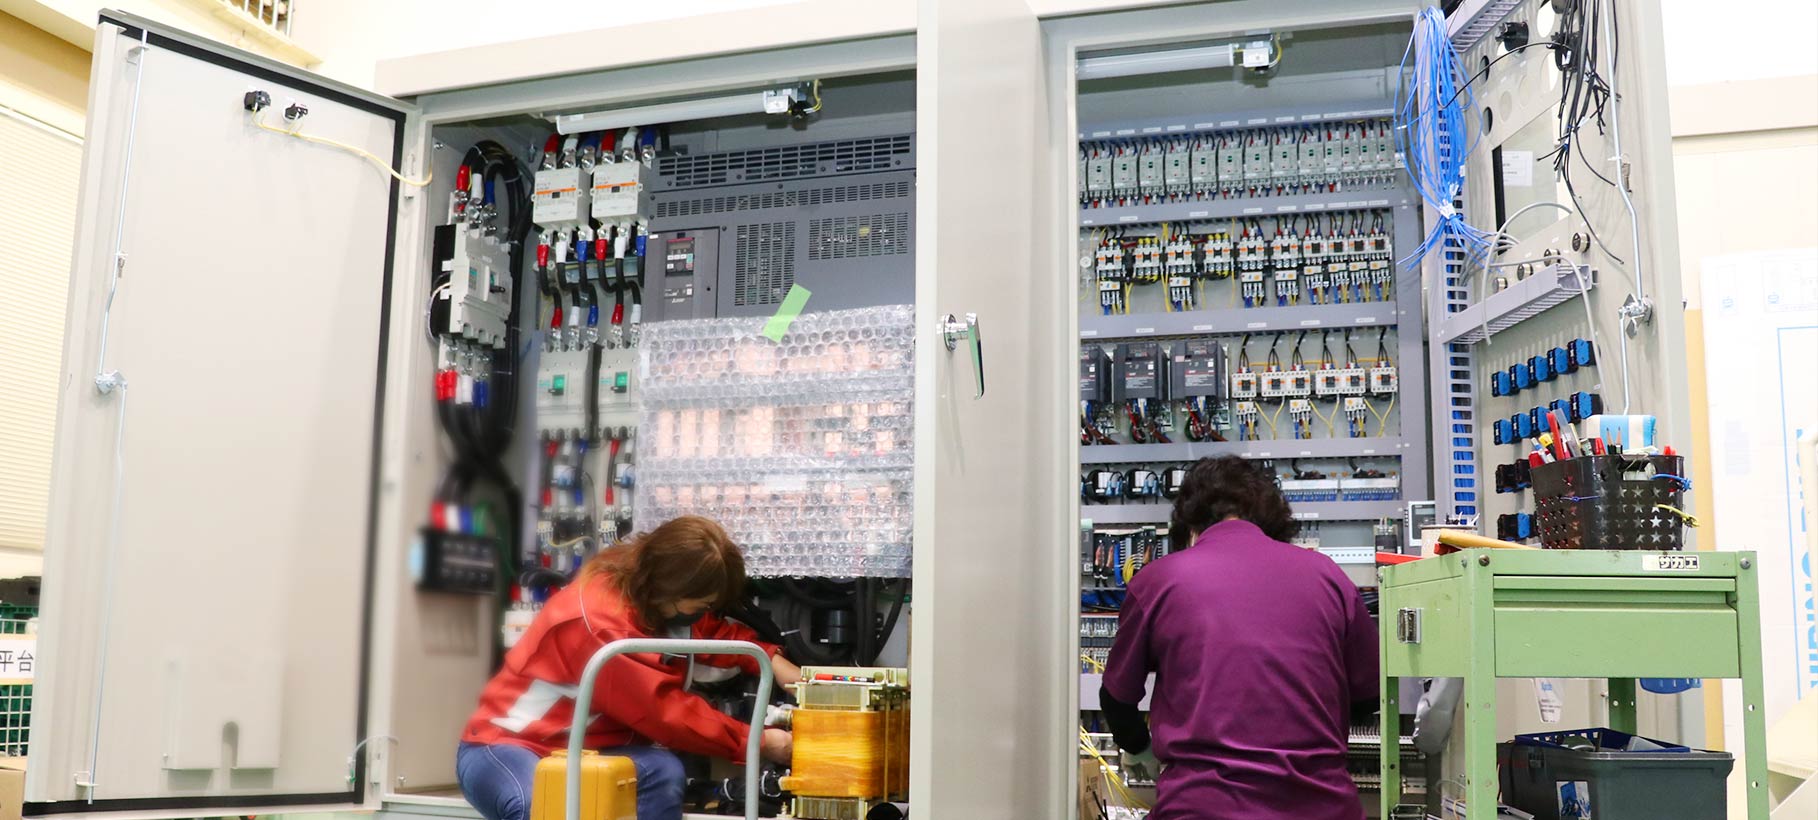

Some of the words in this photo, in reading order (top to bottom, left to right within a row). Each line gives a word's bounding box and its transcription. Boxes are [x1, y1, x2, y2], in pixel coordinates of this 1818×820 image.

[1659, 556, 1697, 569] サカエ
[0, 649, 34, 673] 平台
